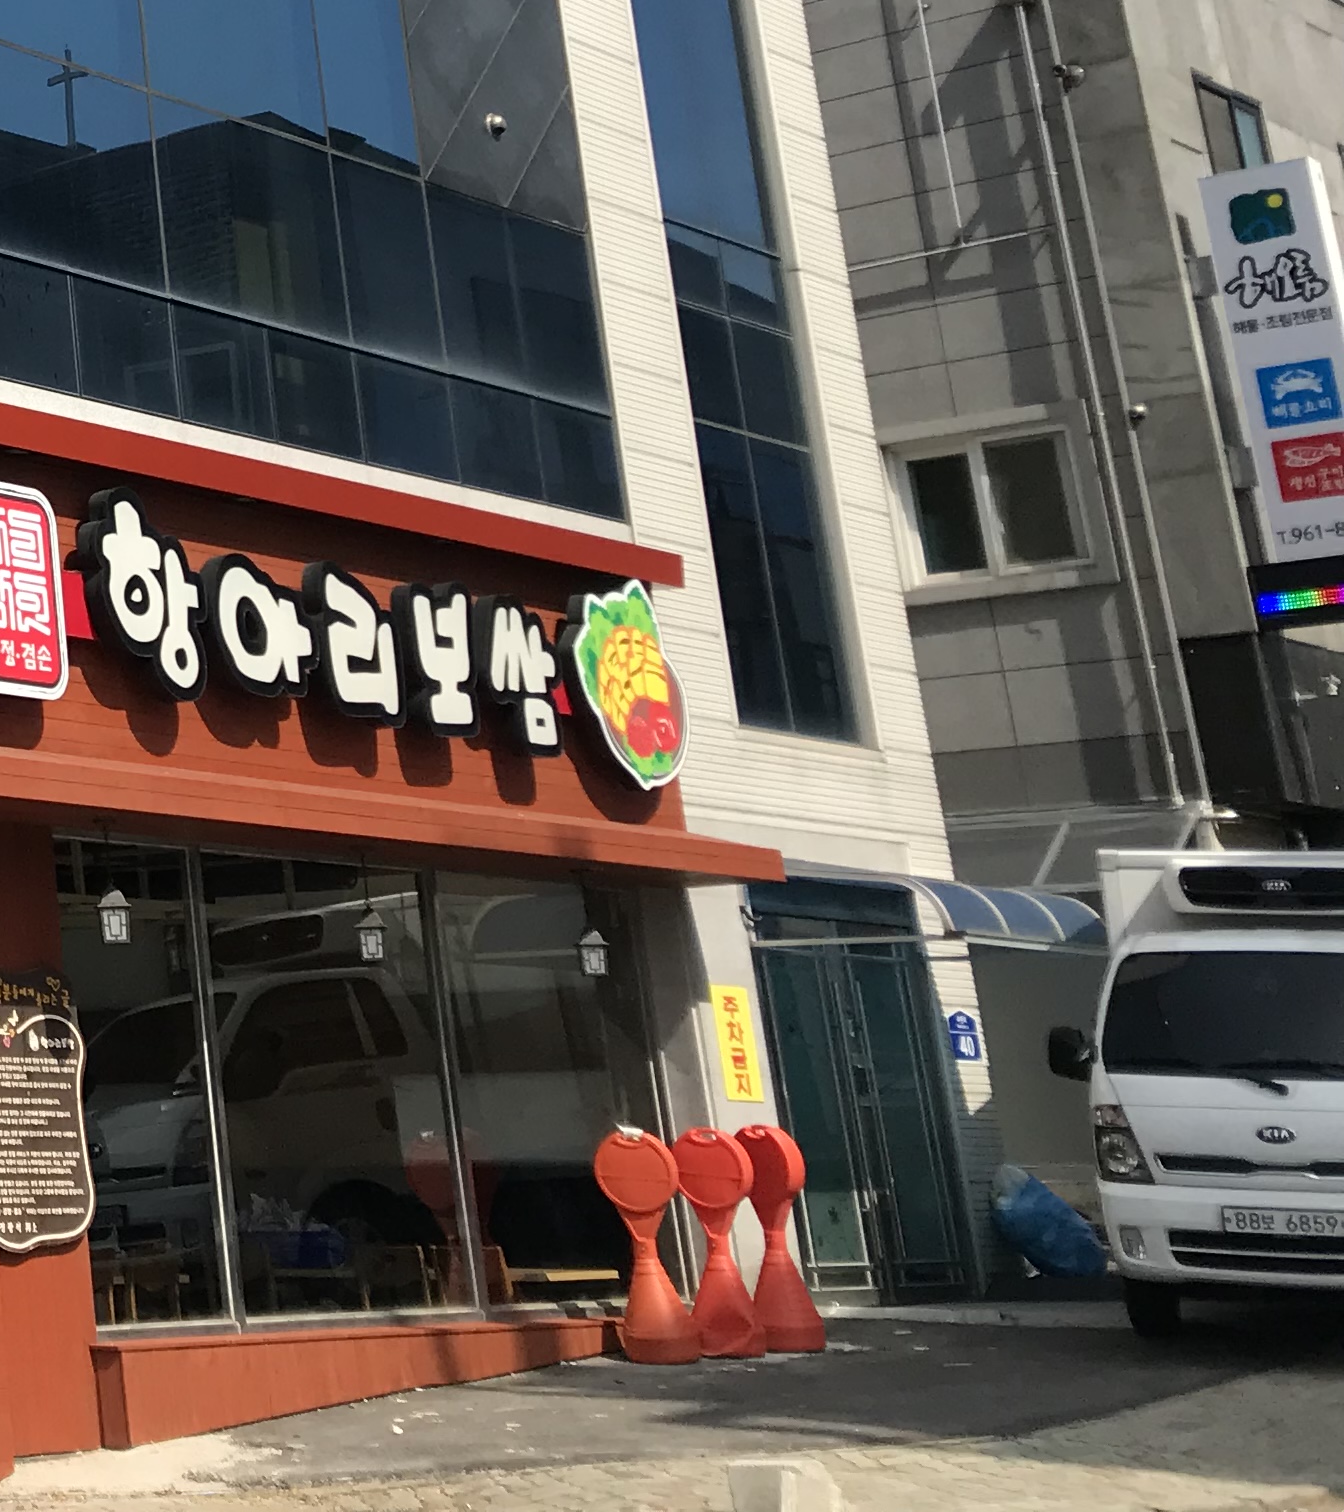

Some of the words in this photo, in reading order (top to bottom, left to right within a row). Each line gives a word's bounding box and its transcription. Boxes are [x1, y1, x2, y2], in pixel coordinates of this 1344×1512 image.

[102, 499, 556, 746] 항아리보쌈
[722, 995, 753, 1096] 주차금지
[1261, 1129, 1291, 1139] KIA
[1286, 1212, 1337, 1234] 6859
